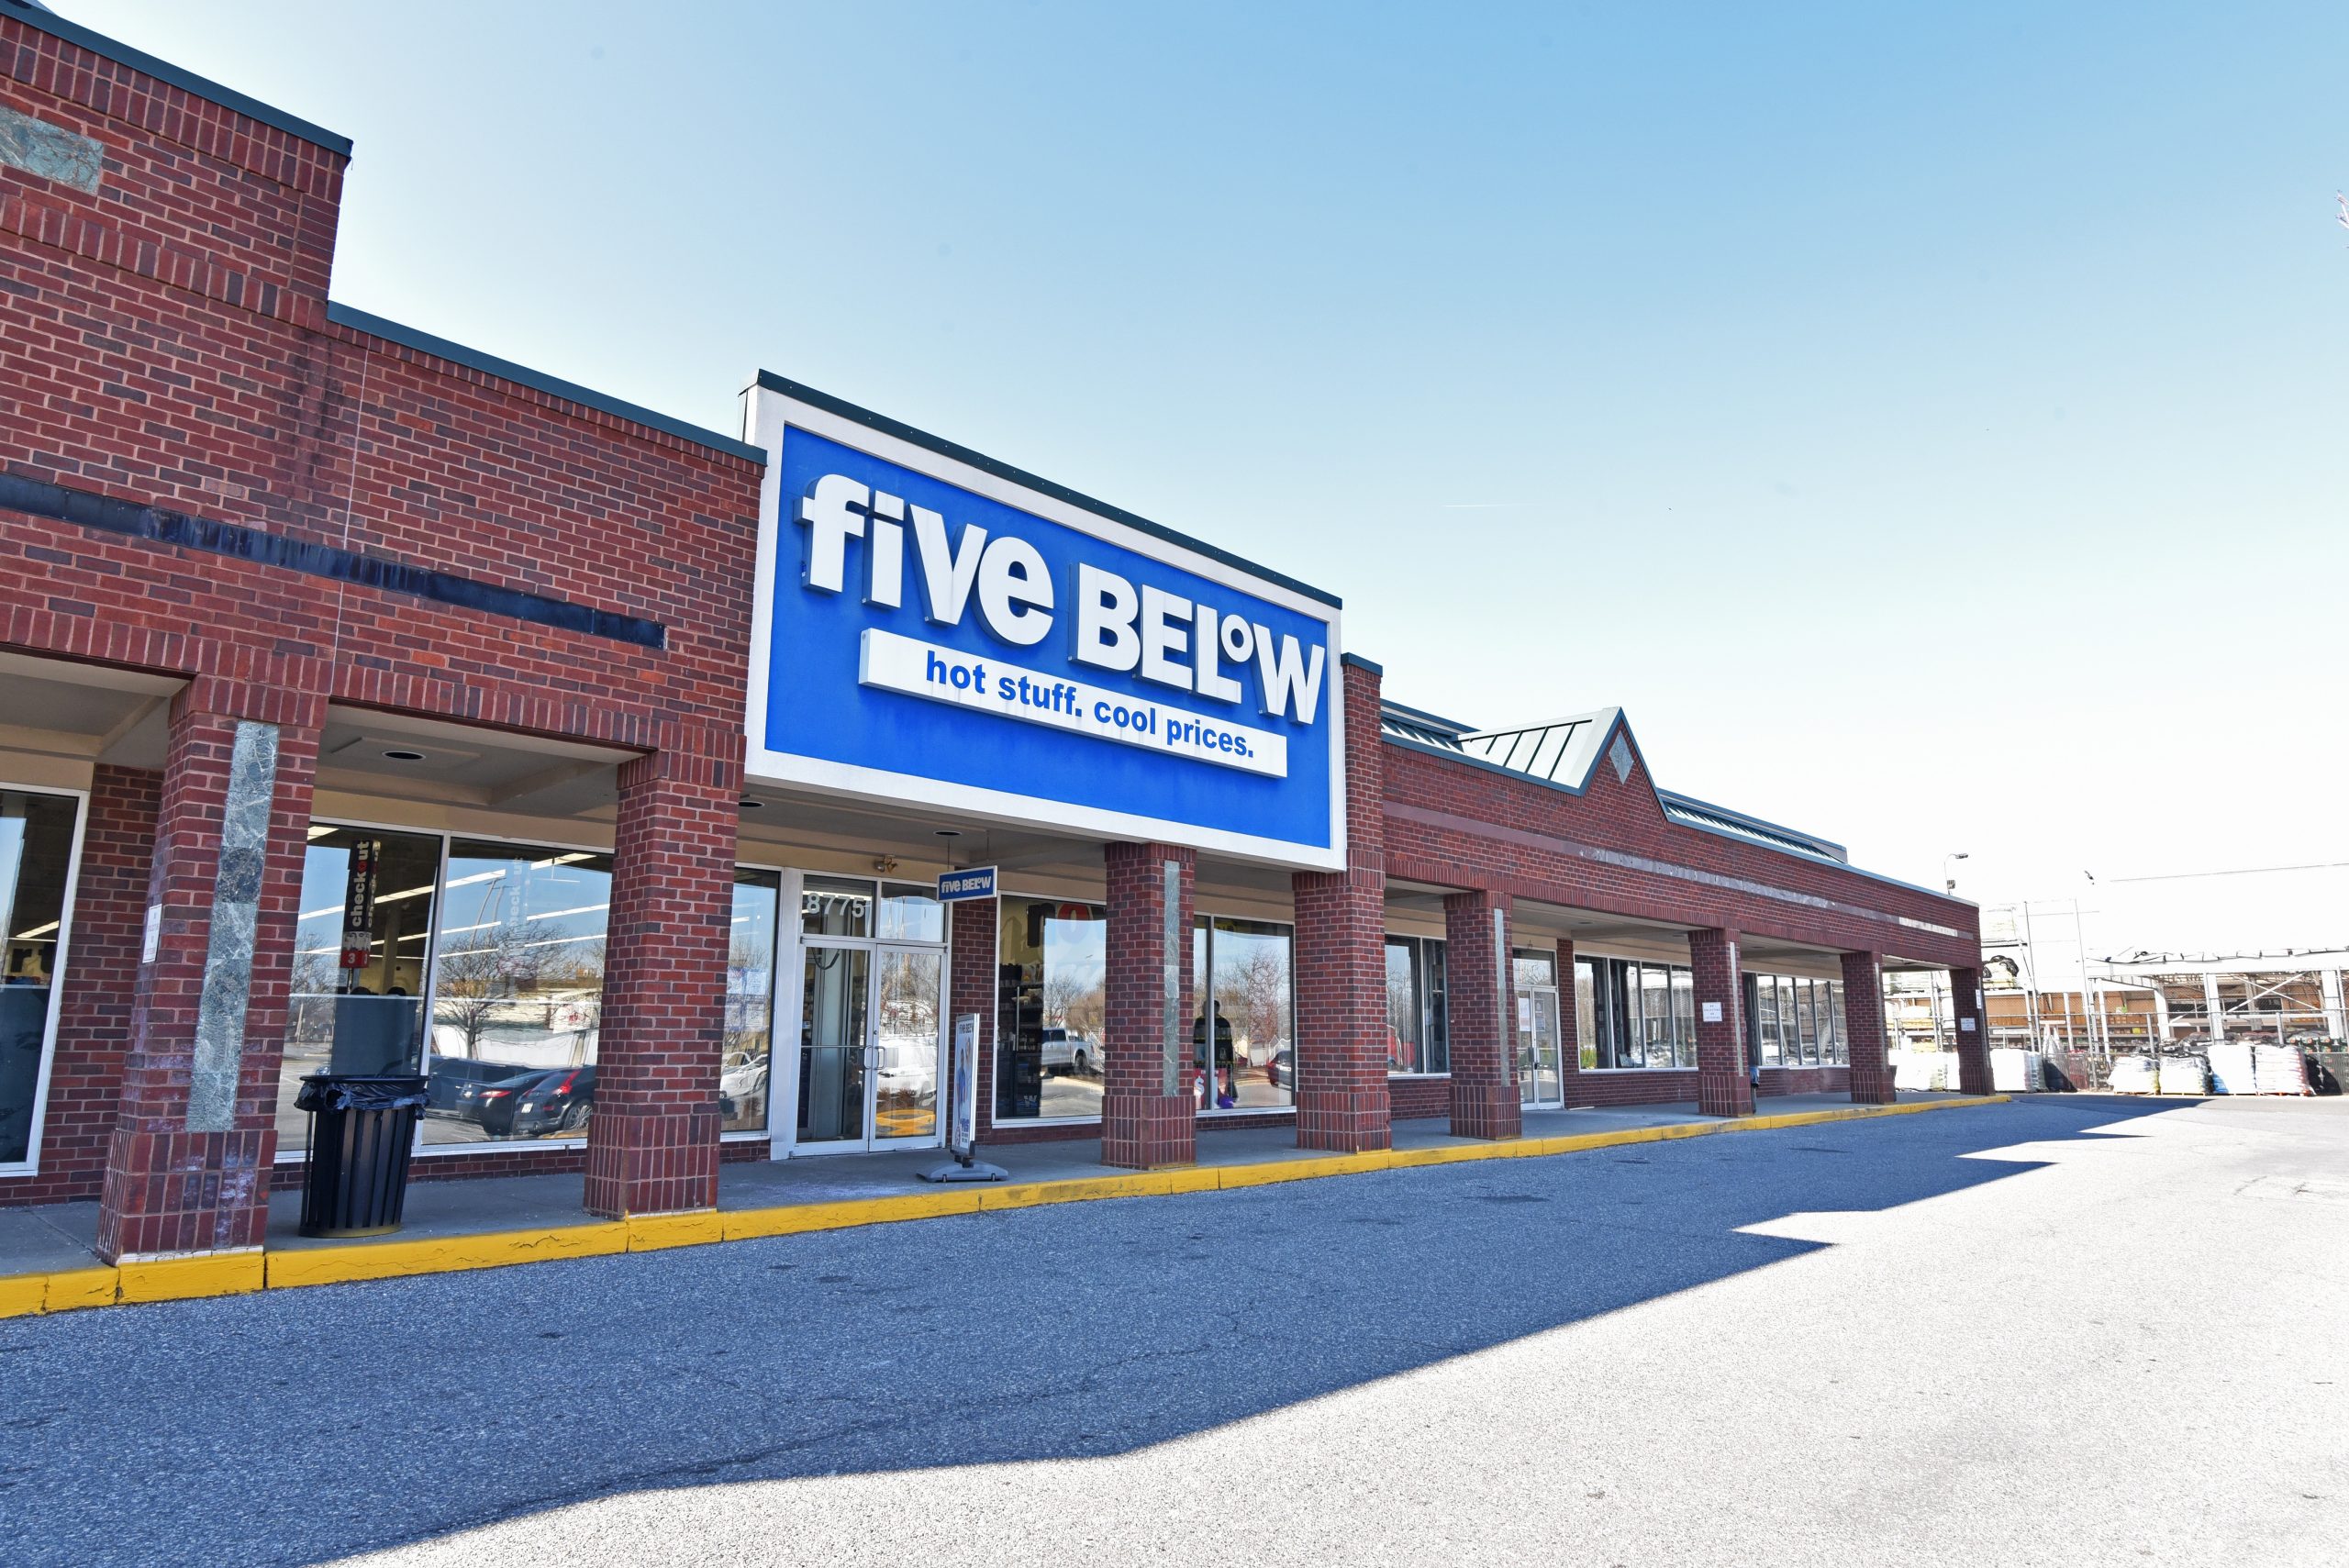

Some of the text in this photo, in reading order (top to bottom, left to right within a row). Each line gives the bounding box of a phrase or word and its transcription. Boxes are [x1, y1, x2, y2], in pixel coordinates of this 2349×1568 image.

[795, 473, 1054, 646] five
[927, 651, 1254, 759] hot stuff. cool prices.
[351, 840, 370, 928] checkout
[807, 892, 865, 918] 8775
[941, 880, 962, 894] five
[348, 952, 356, 964] 3
